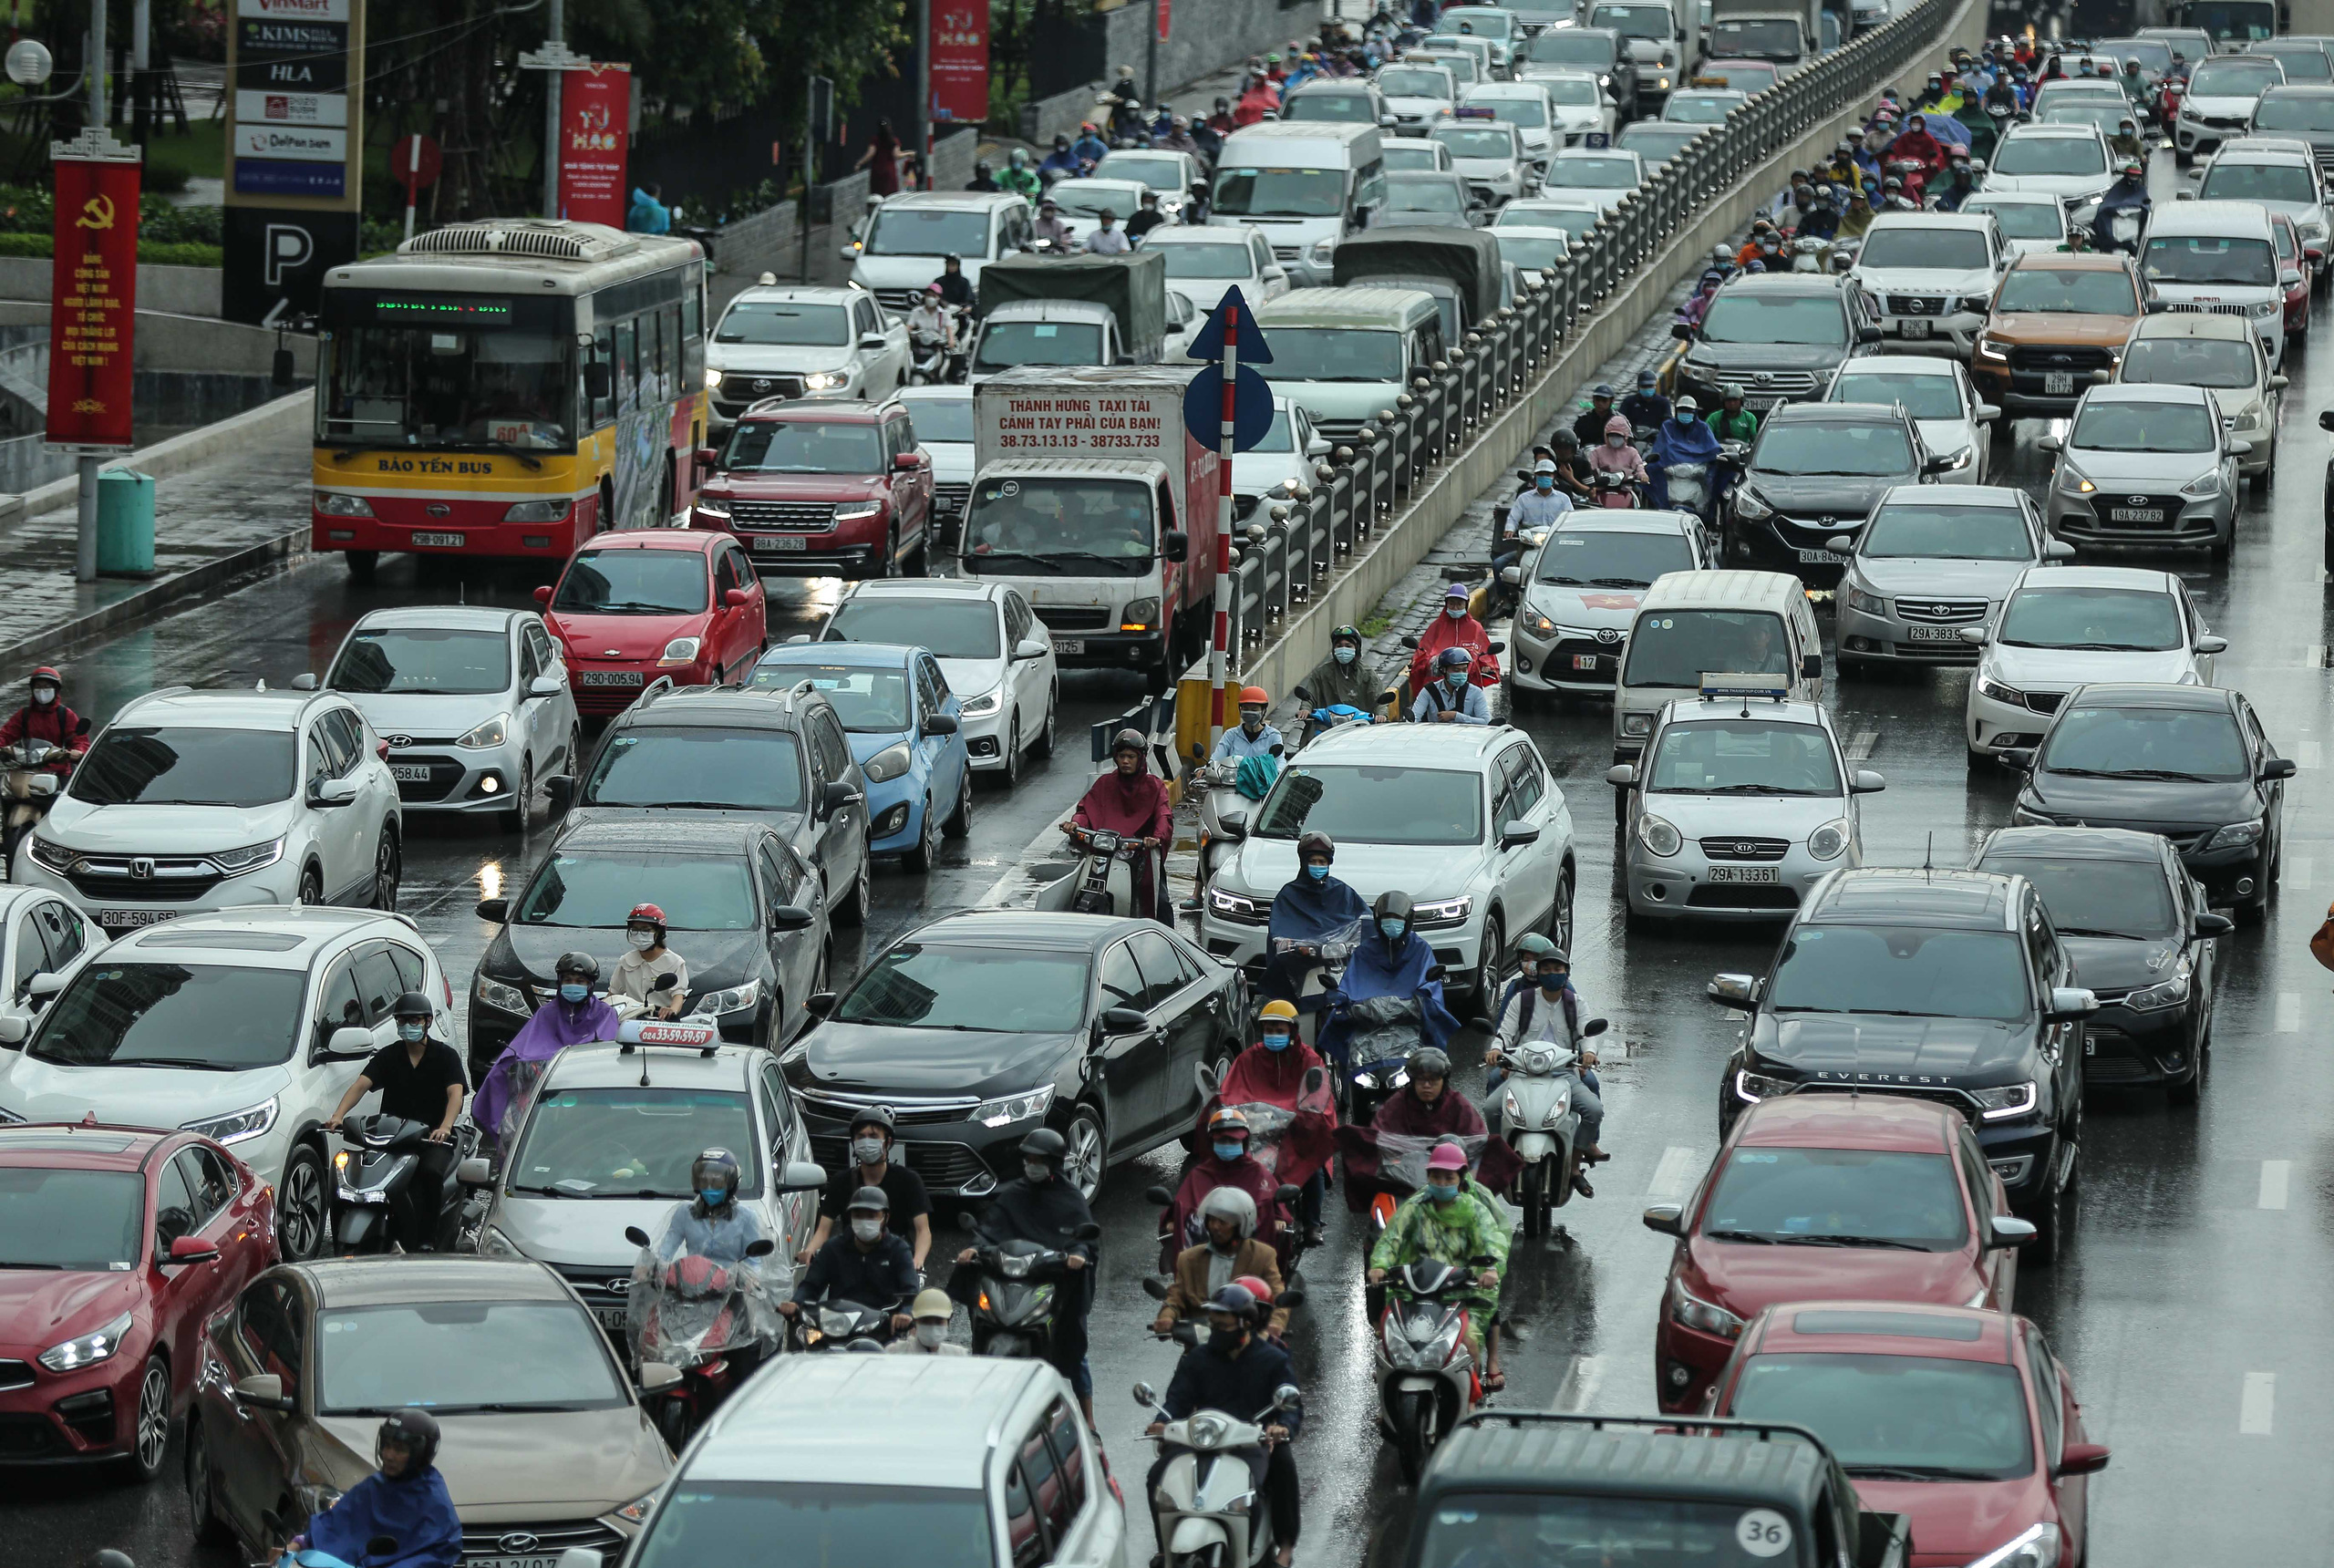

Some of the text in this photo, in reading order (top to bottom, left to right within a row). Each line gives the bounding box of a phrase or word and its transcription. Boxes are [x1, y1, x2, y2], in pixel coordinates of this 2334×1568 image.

[262, 25, 310, 42] KIMS
[271, 64, 313, 82] HLA
[264, 223, 314, 285] P
[1009, 396, 1150, 412] THÀNH HƯNG TAXI TẢI
[1038, 418, 1062, 429] TAY
[1066, 413, 1095, 429] PHẢI
[1100, 413, 1126, 429] CỦA
[1130, 418, 1161, 431] BẠN!
[1000, 435, 1078, 448] 38.73.13.13
[1090, 435, 1160, 448] 38733.733
[378, 457, 491, 474] BẢO YẾN BUS
[585, 674, 641, 685] 29D-005.94
[1817, 1071, 1951, 1084] EVEREST
[1747, 1520, 1781, 1544] 36
